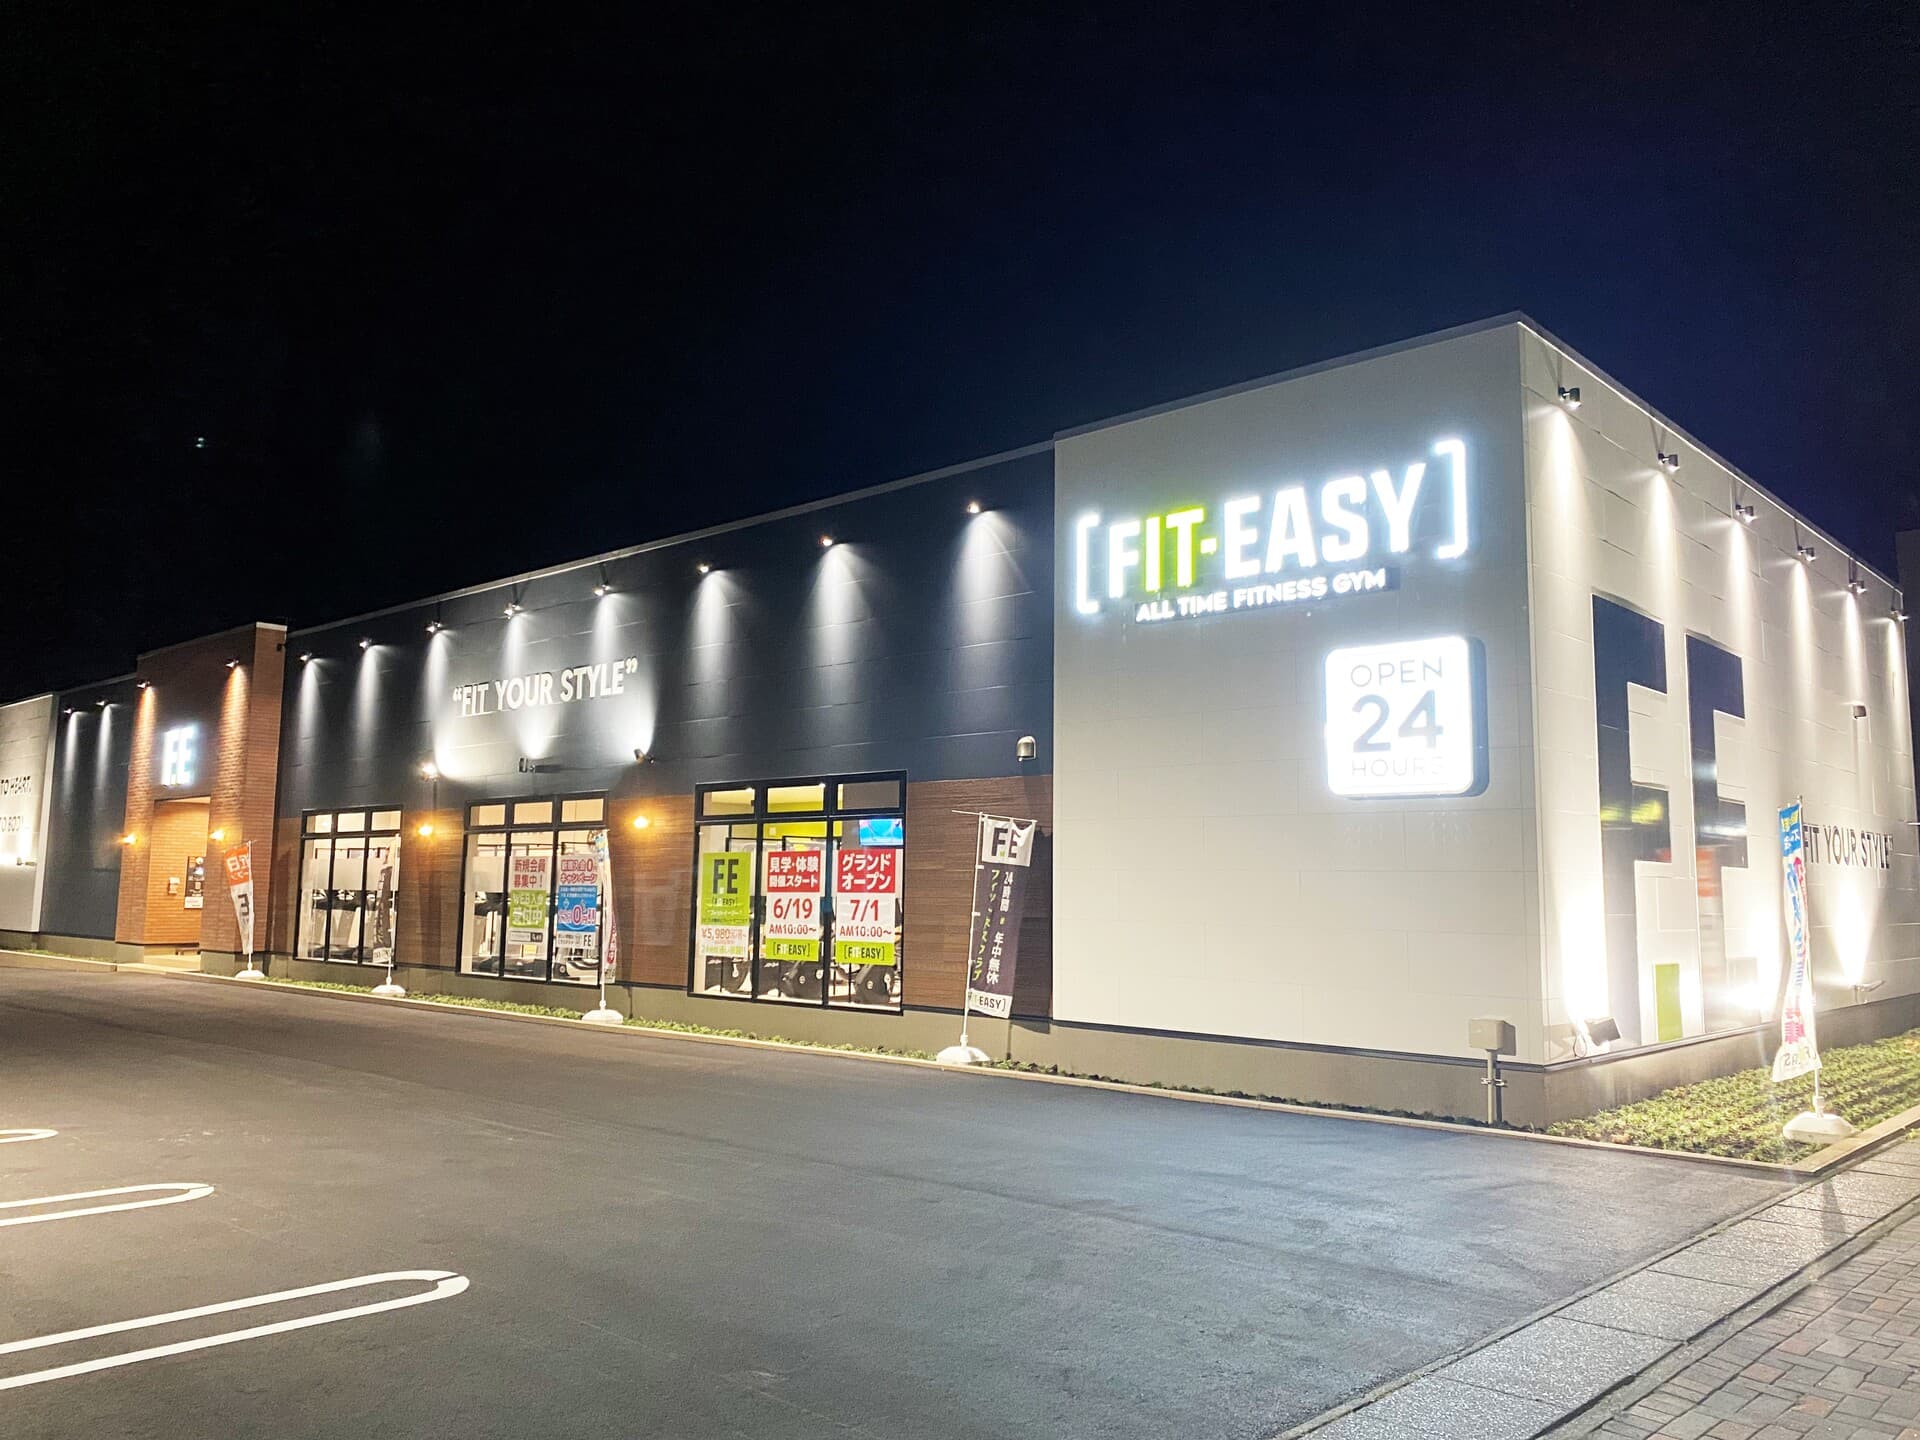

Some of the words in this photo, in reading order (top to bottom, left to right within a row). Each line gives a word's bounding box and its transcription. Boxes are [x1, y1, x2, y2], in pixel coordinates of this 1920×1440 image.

[1136, 603, 1175, 622] ALL
[1177, 592, 1228, 616] TIME
[1233, 577, 1328, 608] FITNESS
[1332, 568, 1386, 594] GYM
[1350, 656, 1442, 687] OPEN
[495, 672, 553, 710] YOUR
[1352, 690, 1444, 753] 24
[842, 853, 891, 871] グランド
[1823, 825, 1859, 866] YOUR
[713, 859, 739, 894] FE
[842, 872, 891, 890] オープン
[773, 898, 813, 919] 6/19
[850, 899, 879, 921] 7/1
